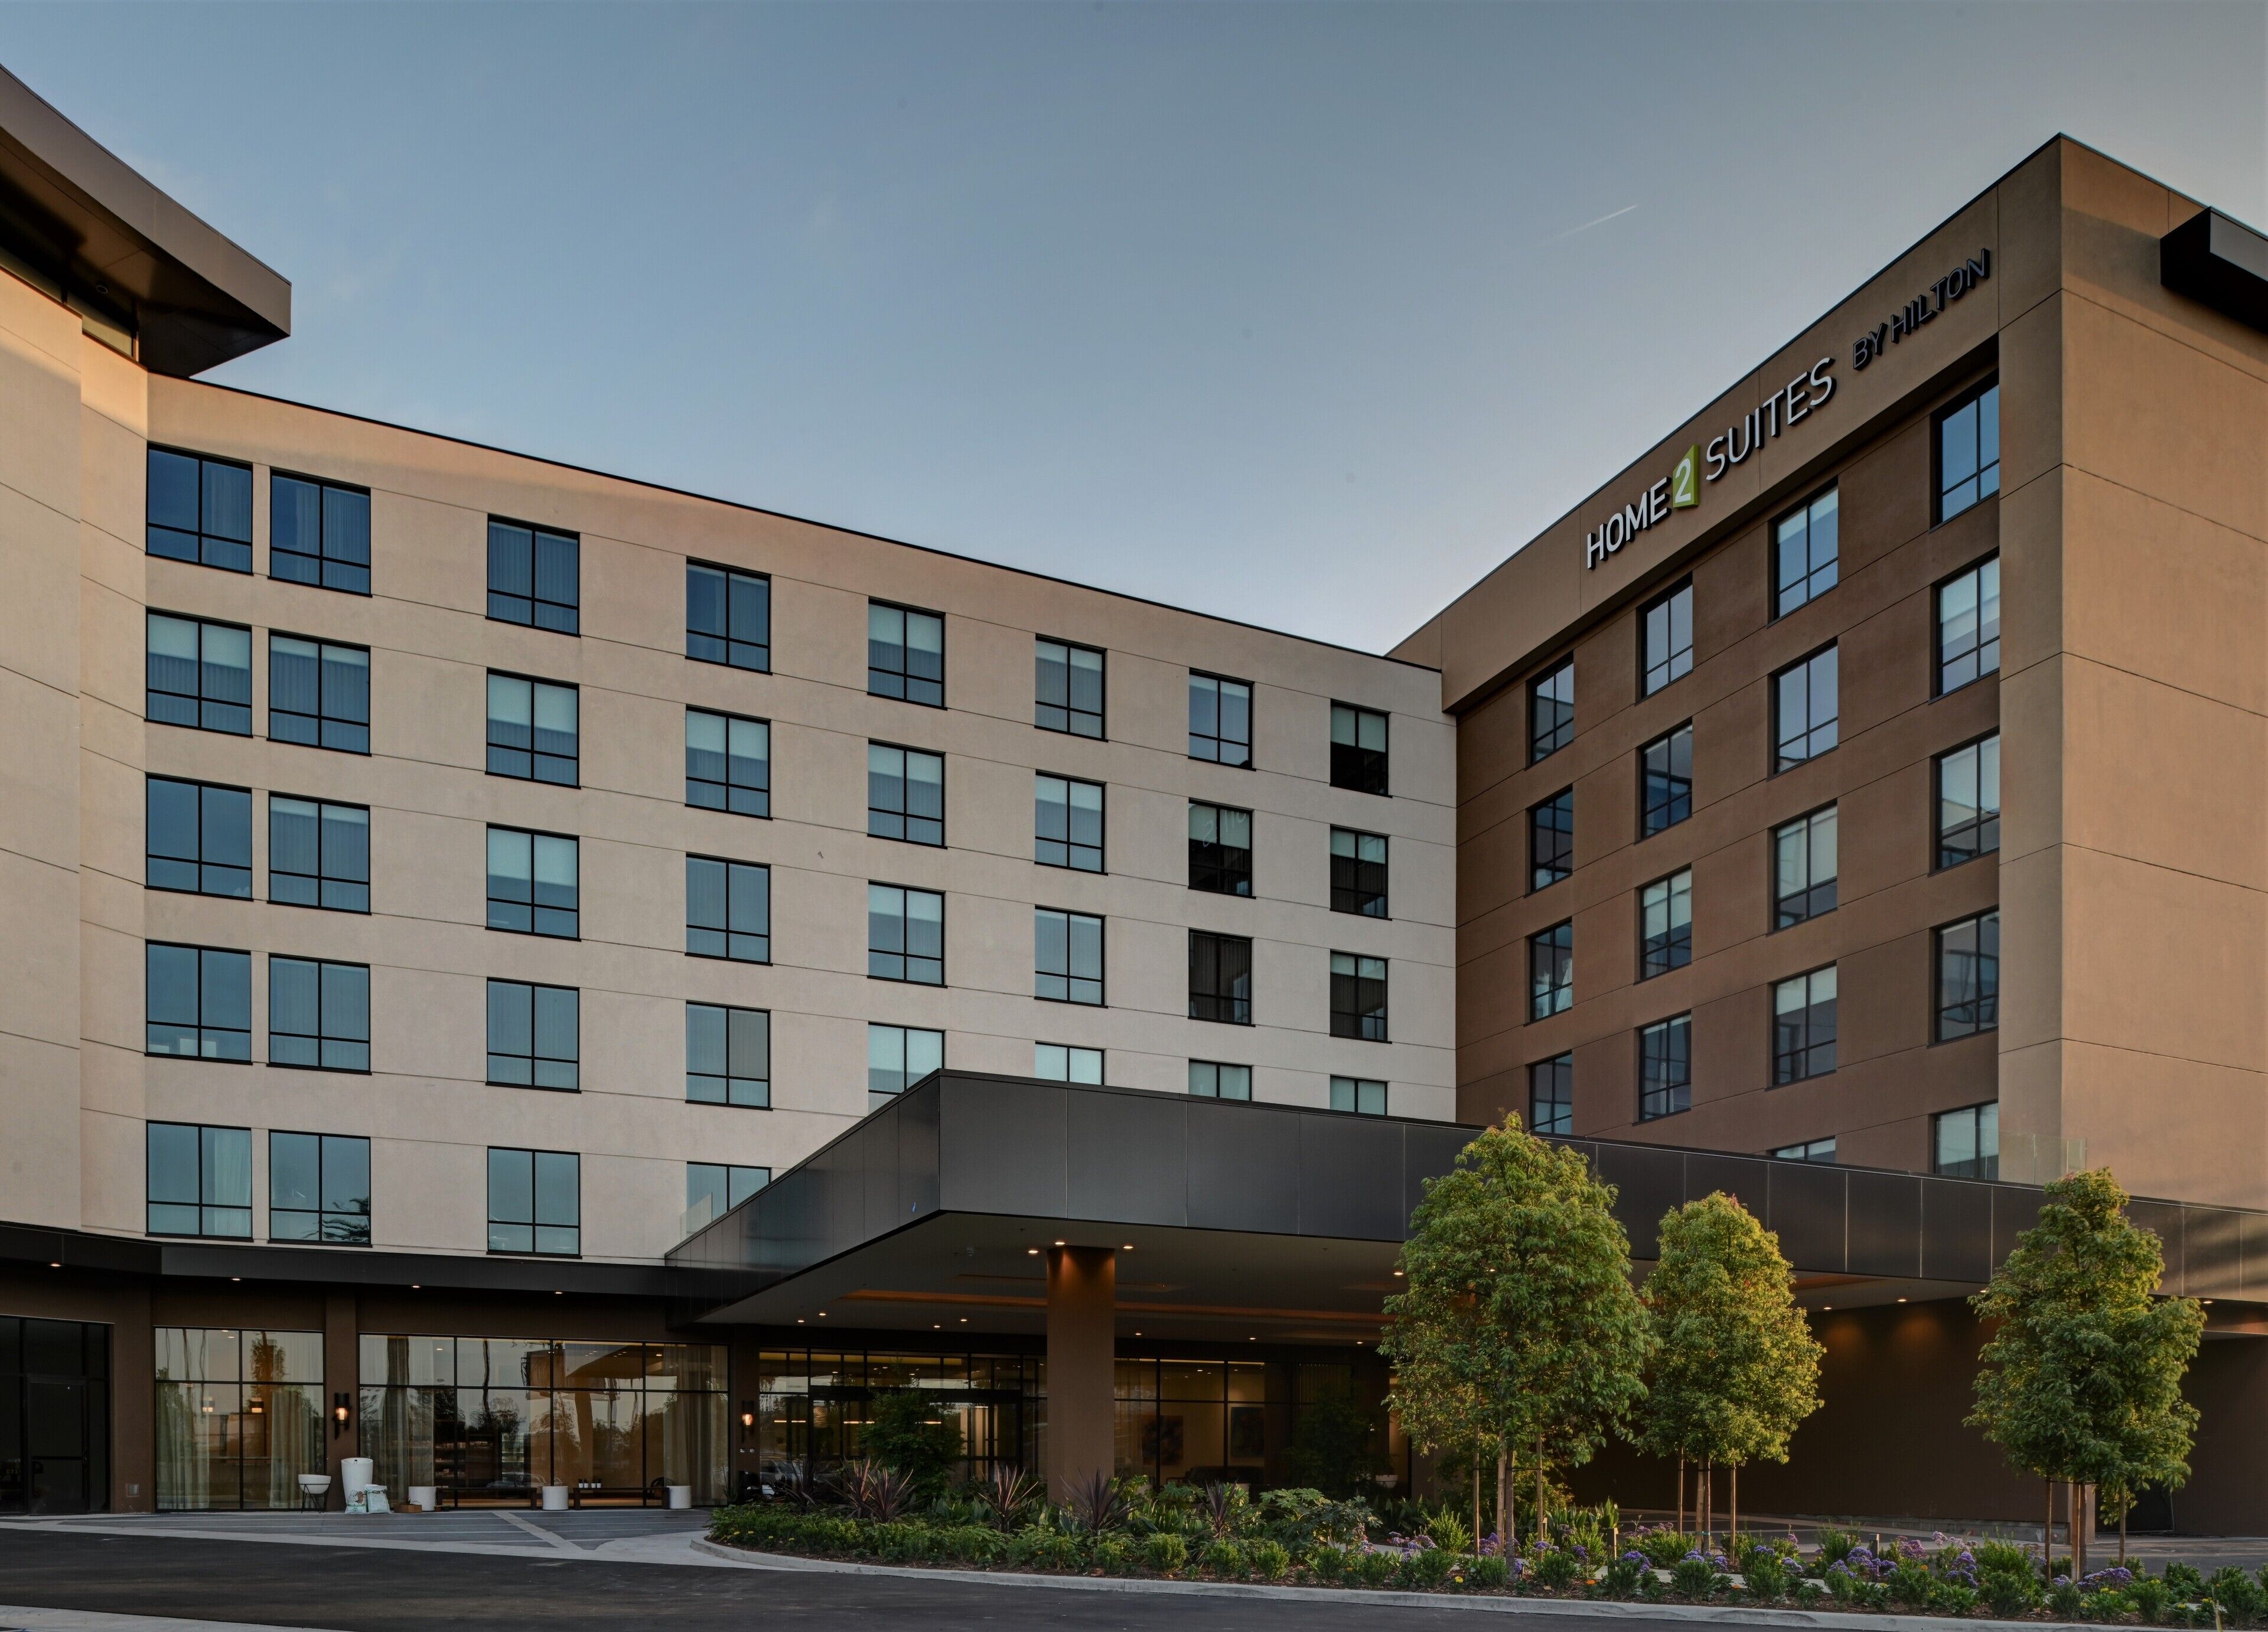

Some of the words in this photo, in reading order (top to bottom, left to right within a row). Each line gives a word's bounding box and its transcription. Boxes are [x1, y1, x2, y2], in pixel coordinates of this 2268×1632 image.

[1706, 357, 1834, 481] SUITES
[1853, 323, 1885, 370] BY
[1891, 248, 1988, 343] HILTON
